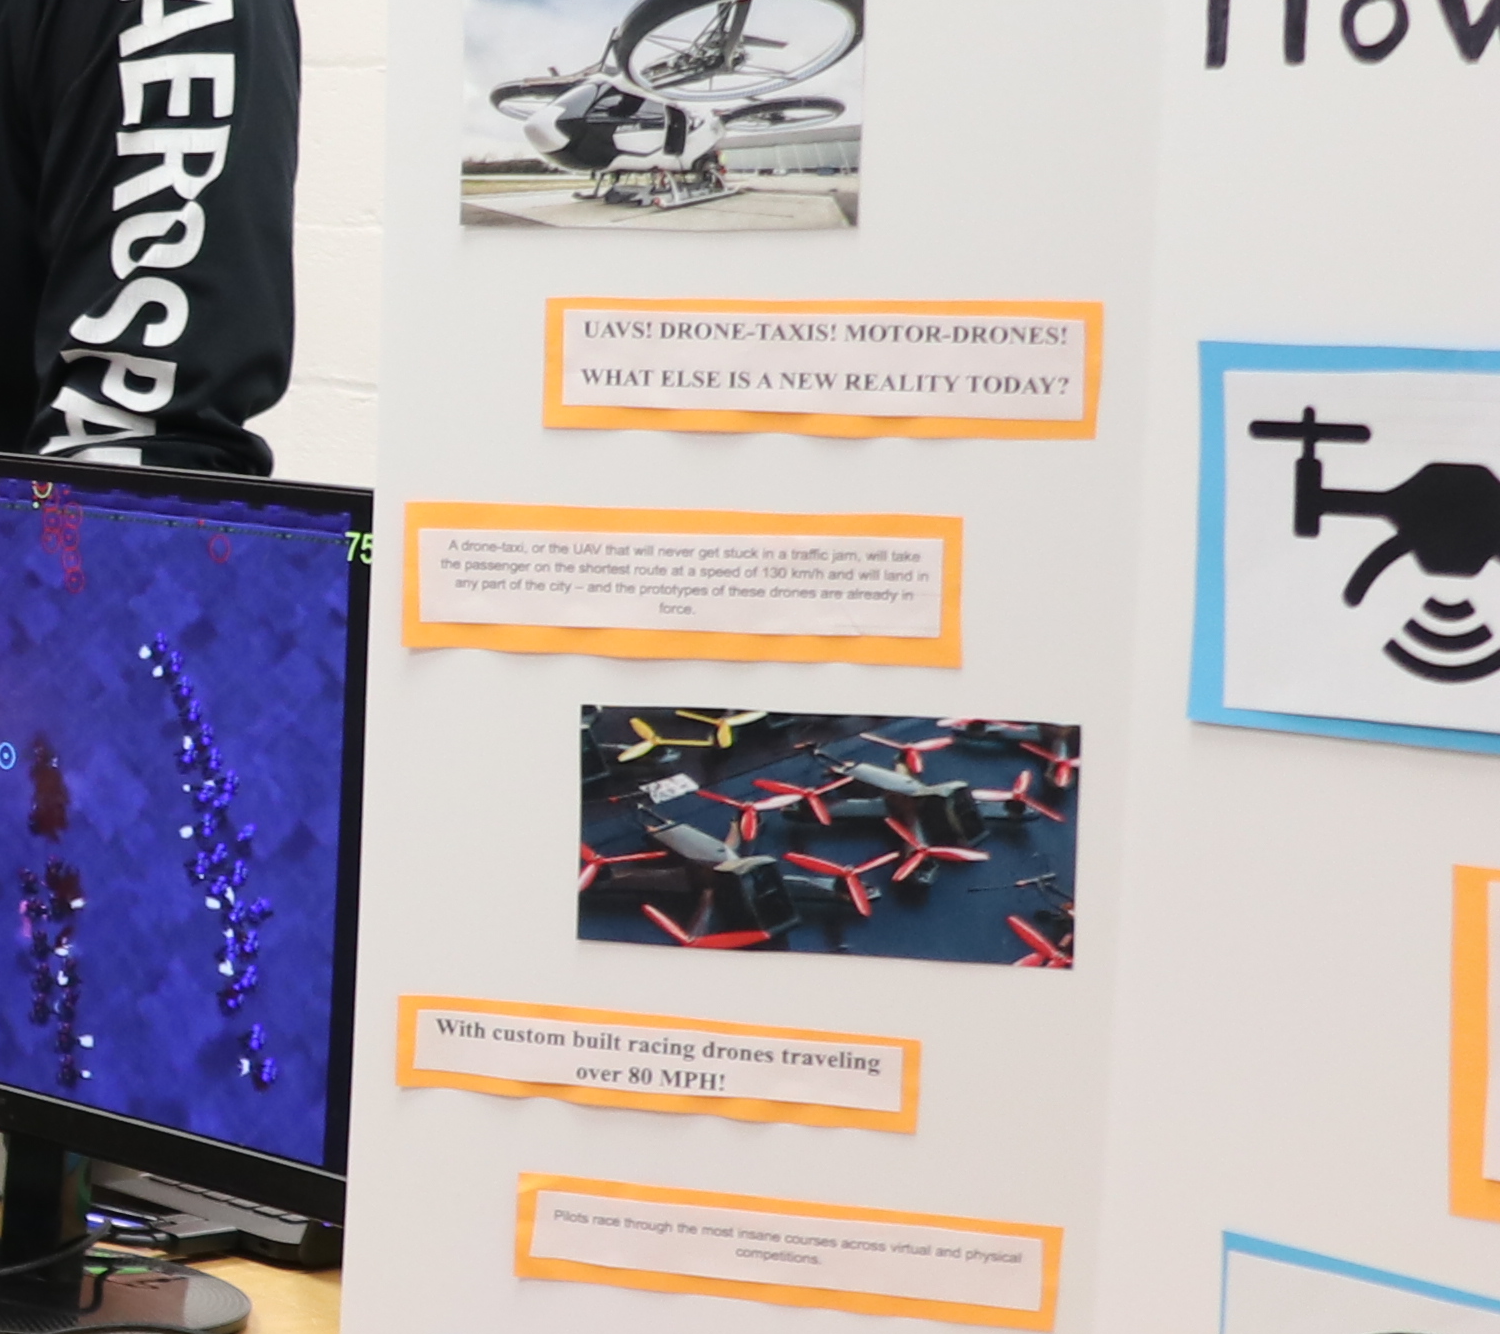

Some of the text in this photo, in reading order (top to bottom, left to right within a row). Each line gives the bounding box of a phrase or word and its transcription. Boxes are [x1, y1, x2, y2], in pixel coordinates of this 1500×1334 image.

[584, 320, 1067, 345] UAVS! DRONE-TAXIS! MOTOR-DRONES!
[581, 368, 1070, 395] WHAT ELSE IS A NEW REALITY TODAY?
[447, 538, 922, 565] A drone-taxi, or the UAV that will never get stuck in a traffic jam, will take
[439, 557, 930, 583] the passenger on the shortest route at a speed of 130 km/h and will land in
[454, 578, 479, 592] any
[481, 578, 507, 592] part
[508, 578, 523, 591] of
[524, 578, 547, 592] the
[548, 580, 573, 595] city
[586, 581, 613, 594] and
[614, 581, 637, 595] the
[638, 583, 709, 599] prototypes
[711, 584, 726, 597] of
[727, 585, 767, 598] these
[769, 585, 818, 599] drones
[819, 588, 845, 600] are
[846, 587, 900, 604] already
[901, 589, 916, 601] in
[658, 601, 696, 616] force.
[435, 1017, 881, 1074] With custom built racing drones traveling
[575, 1065, 726, 1092] over 80 MPH!
[553, 1208, 1024, 1265] Pilots race through the most insane courses across virtual and physical
[734, 1247, 823, 1266] competitions.
